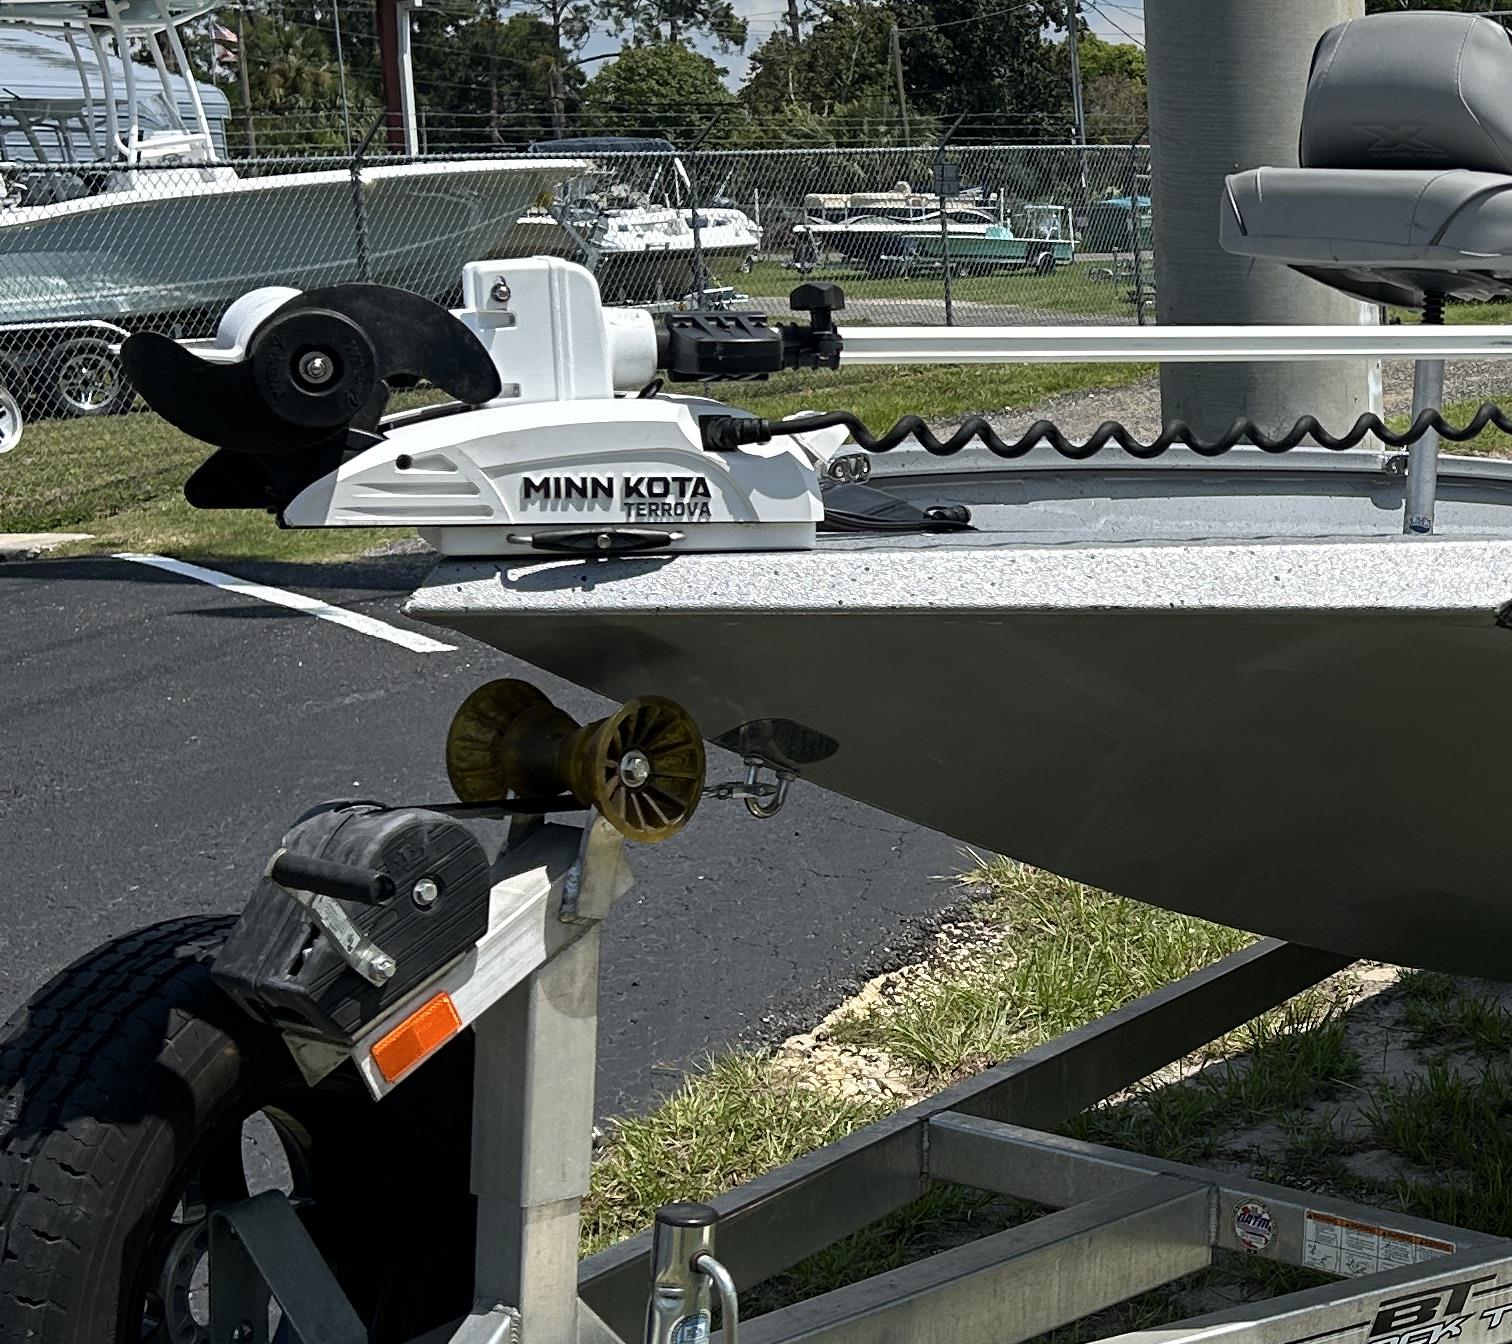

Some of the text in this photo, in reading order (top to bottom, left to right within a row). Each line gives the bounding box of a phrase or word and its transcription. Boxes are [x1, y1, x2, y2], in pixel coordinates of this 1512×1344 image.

[523, 477, 711, 499] MINN KOTA
[624, 502, 711, 517] TERROVA
[1370, 1273, 1497, 1338] BT
